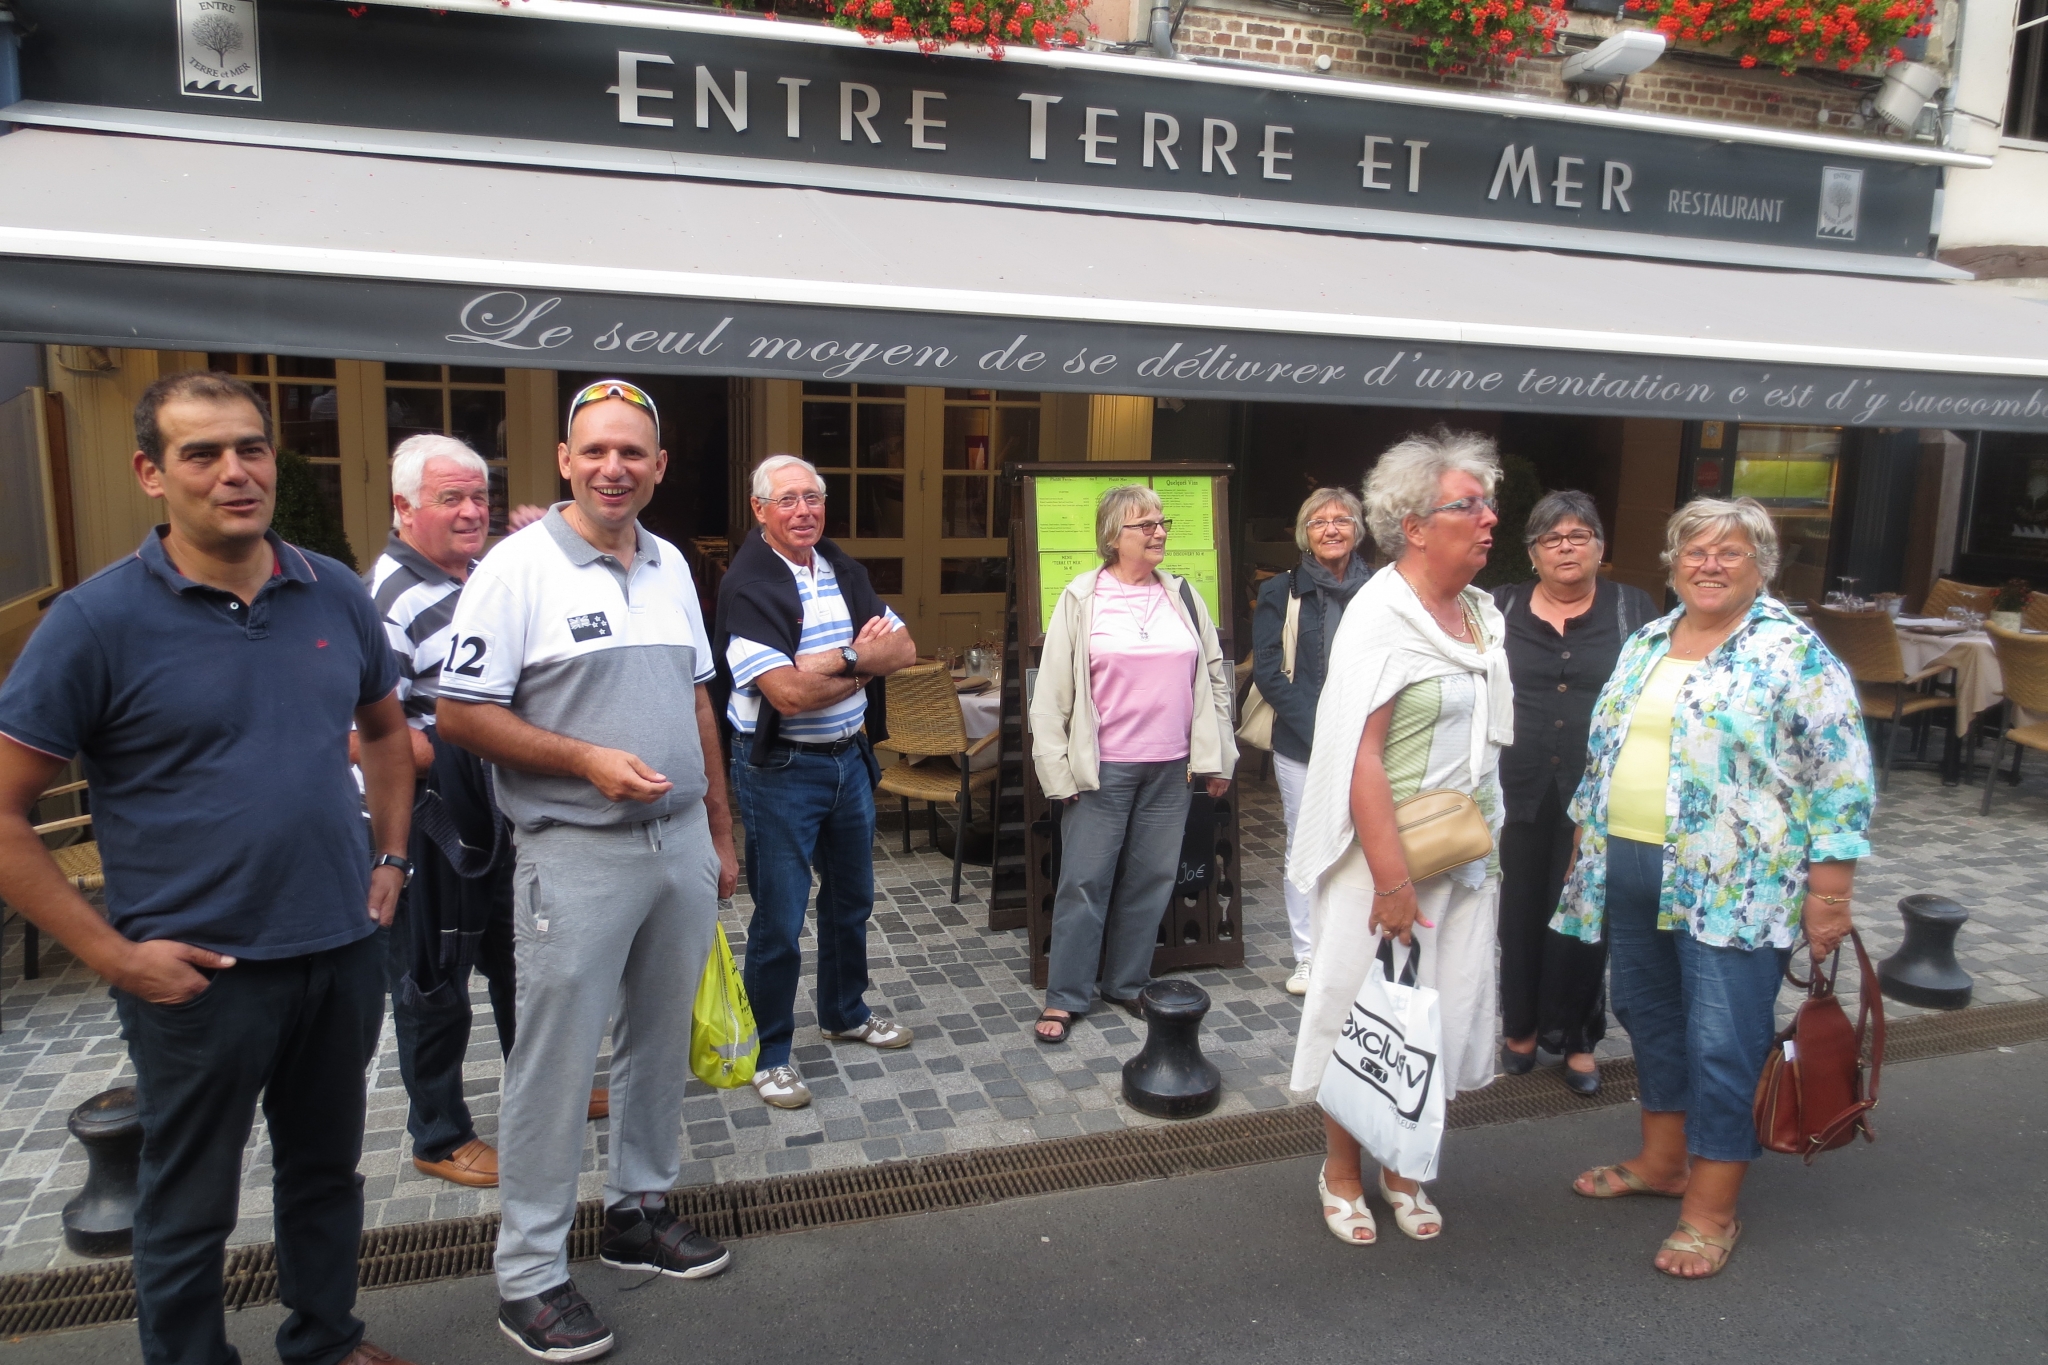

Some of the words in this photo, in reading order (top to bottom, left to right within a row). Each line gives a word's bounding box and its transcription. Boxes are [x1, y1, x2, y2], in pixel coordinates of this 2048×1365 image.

[199, 1, 236, 14] ENTRE
[189, 56, 219, 78] TERRE
[230, 62, 251, 78] MER
[605, 50, 948, 151] ENTRE
[1017, 92, 1295, 181] TERRE
[1357, 134, 1431, 193] ET
[1488, 143, 1633, 213] MER
[1667, 188, 1785, 223] RESTAURANT
[445, 290, 574, 351] Le
[593, 317, 734, 357] seul
[748, 336, 958, 379] moyen
[978, 334, 1051, 372] de
[1062, 346, 1118, 375] se
[1137, 342, 1346, 385] délivrer
[1363, 351, 1504, 392] d'une
[1516, 367, 1715, 404] tentation
[1727, 373, 1816, 410] c'est
[1825, 378, 1891, 424] d'y
[443, 632, 487, 678] 12
